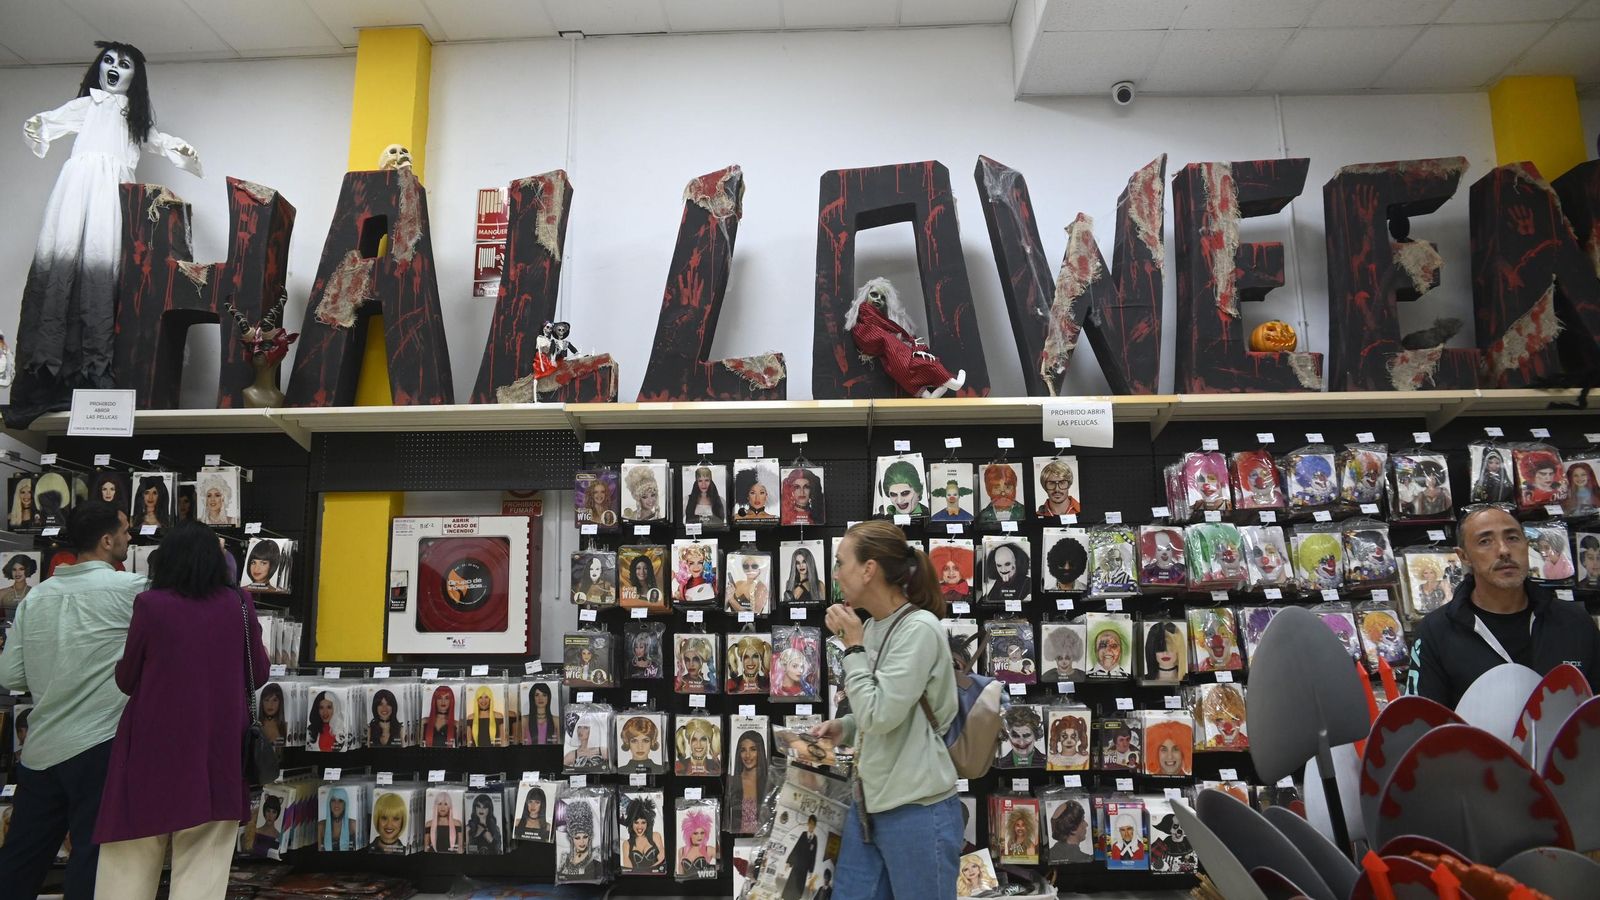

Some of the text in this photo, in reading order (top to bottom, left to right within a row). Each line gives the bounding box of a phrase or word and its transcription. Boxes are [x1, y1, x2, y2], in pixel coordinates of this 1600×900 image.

[577, 513, 592, 521] WIG
[622, 591, 637, 599] WIG
[995, 662, 1009, 671] WIG
[565, 671, 580, 679] WIG
[1104, 756, 1117, 764] WIG
[697, 870, 715, 878] WIG
